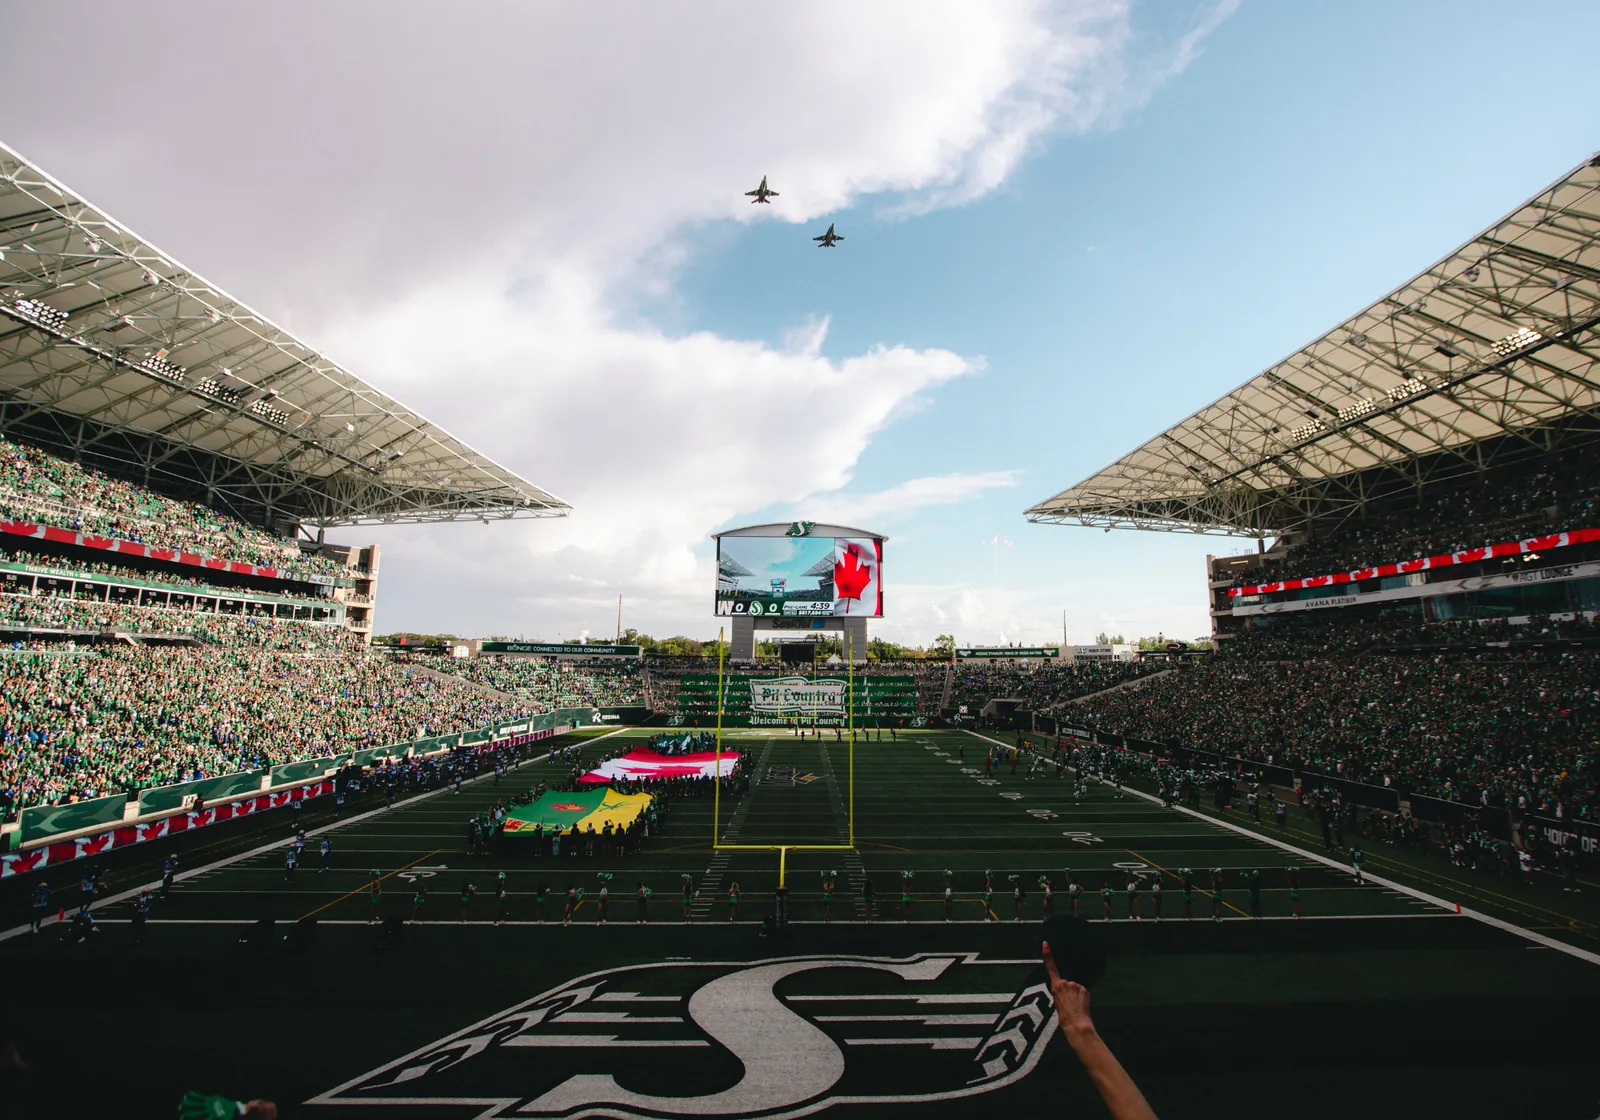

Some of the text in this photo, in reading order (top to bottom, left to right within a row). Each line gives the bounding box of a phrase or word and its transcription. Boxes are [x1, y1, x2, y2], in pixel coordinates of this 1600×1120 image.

[25, 565, 49, 574] THRIVE
[49, 568, 74, 578] WEALTH
[1520, 565, 1575, 583] AGT LOUNGE
[318, 576, 332, 585] 4:39
[810, 602, 830, 610] 4:39
[1305, 596, 1357, 608] AVANA PLATINUM
[717, 600, 735, 616] W
[533, 645, 563, 653] CONNECTED
[751, 716, 786, 725] Welcome
[800, 717, 812, 725] Pil
